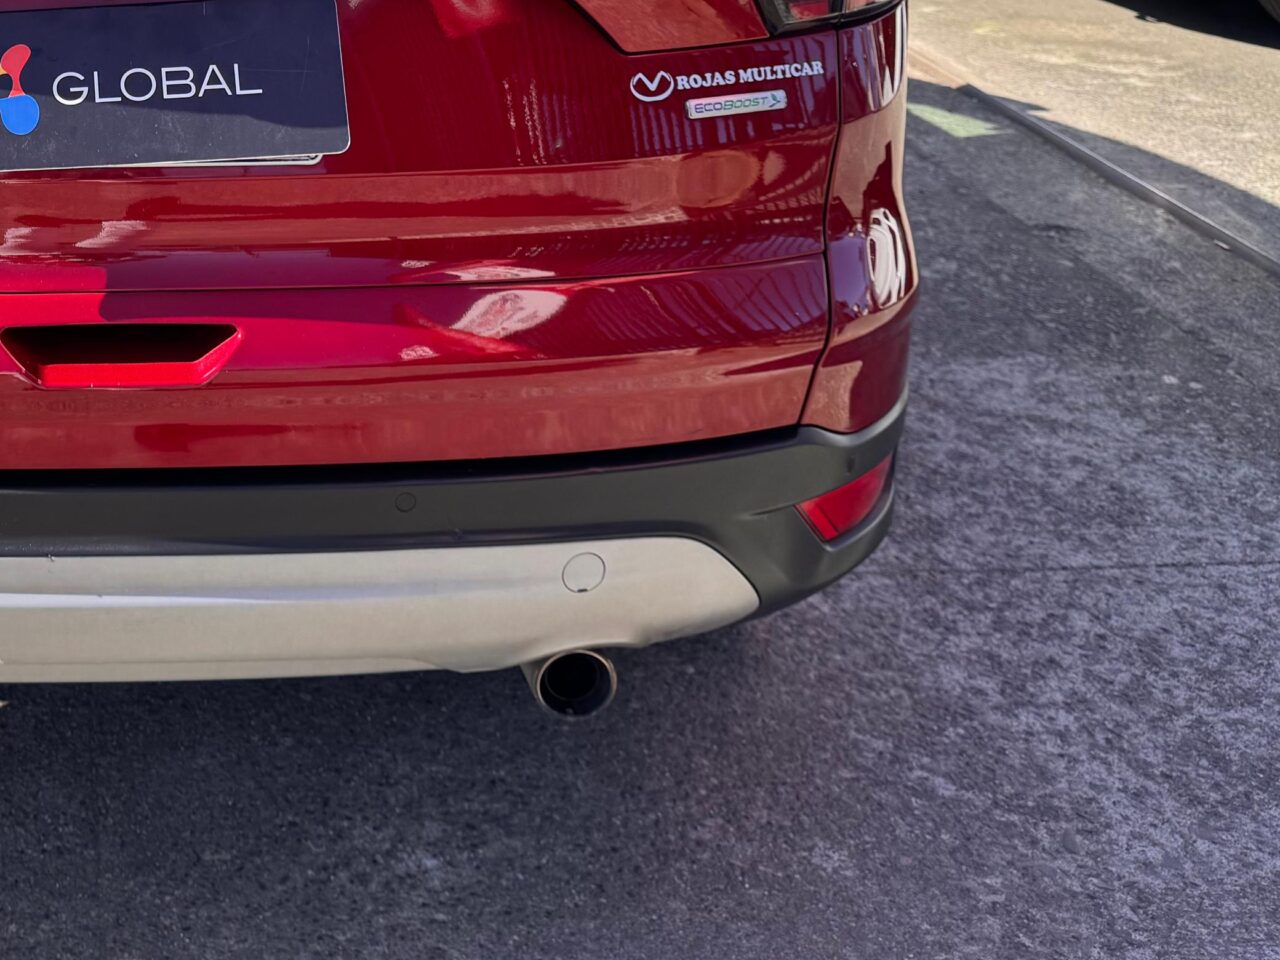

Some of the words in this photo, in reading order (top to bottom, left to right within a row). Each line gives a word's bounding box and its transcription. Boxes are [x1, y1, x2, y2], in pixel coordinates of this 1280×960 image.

[52, 63, 264, 106] GLOBAL
[676, 71, 736, 90] ROJAS
[738, 60, 824, 83] MULTICAR
[694, 96, 769, 114] ECOBOOST
